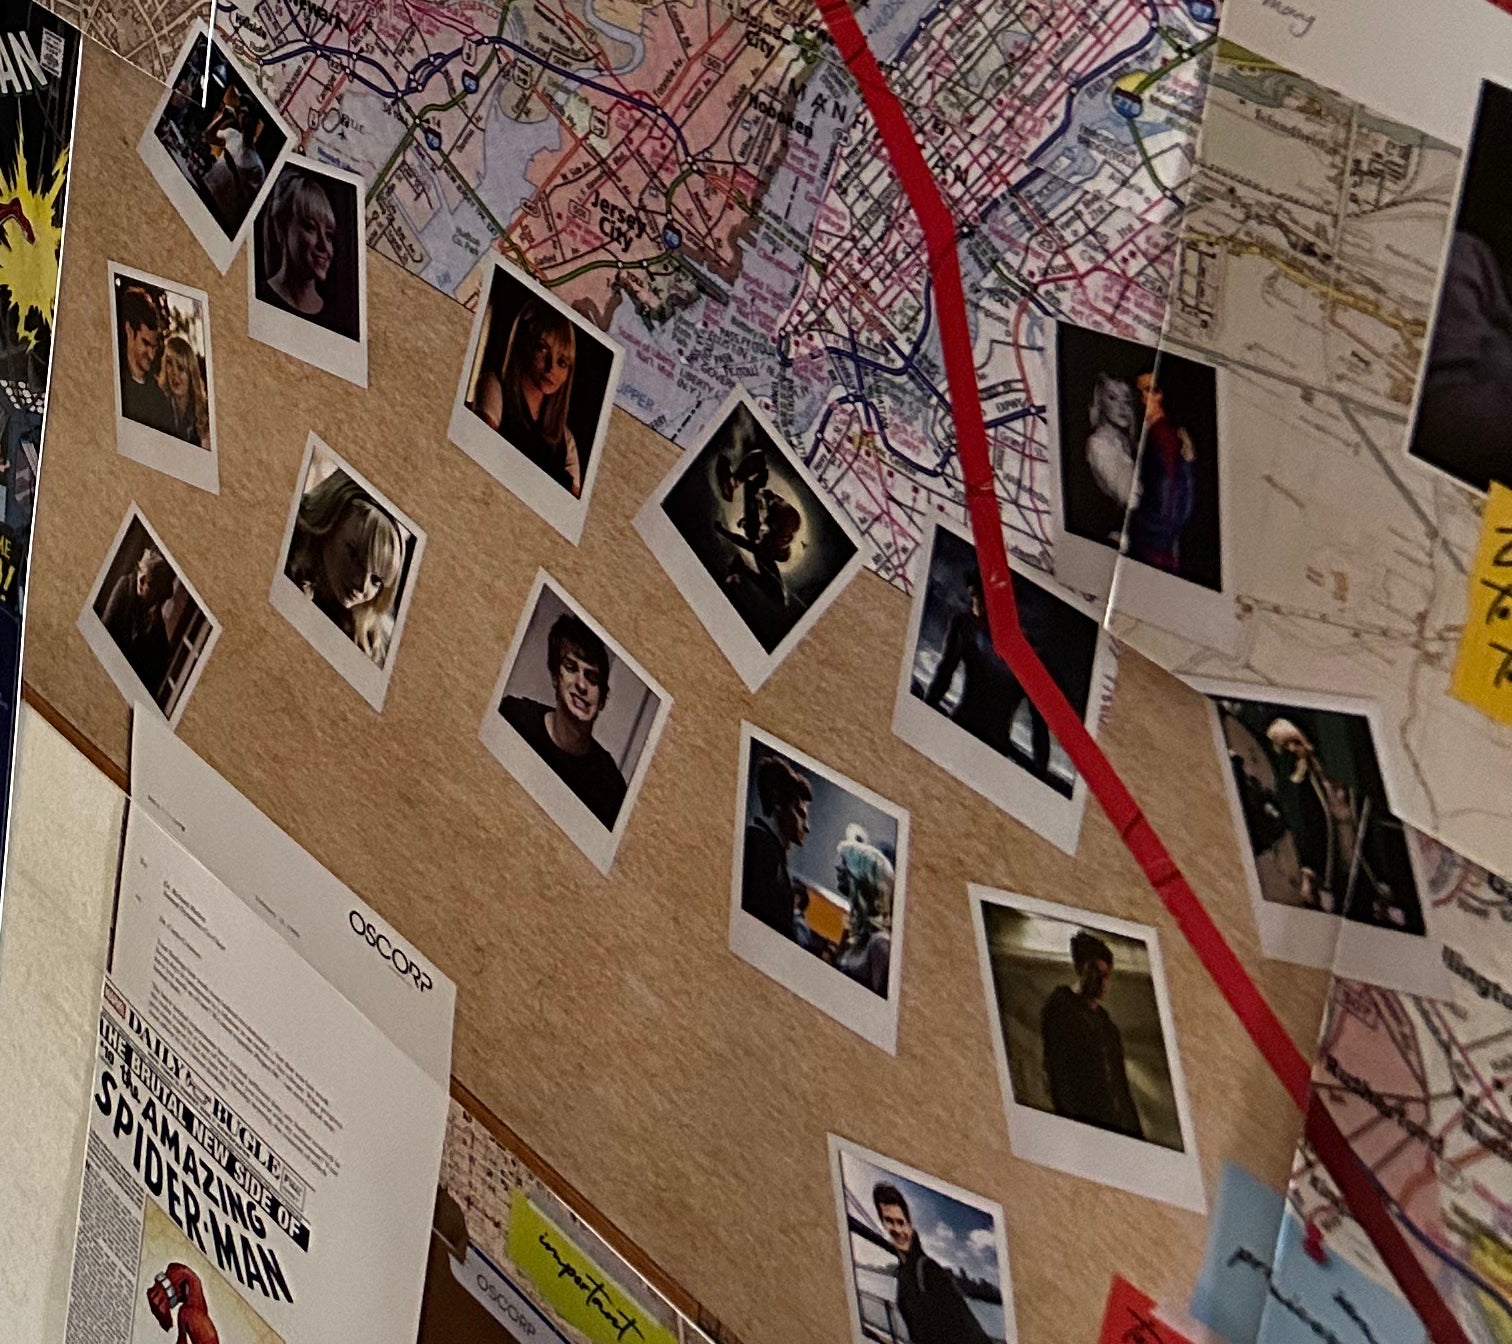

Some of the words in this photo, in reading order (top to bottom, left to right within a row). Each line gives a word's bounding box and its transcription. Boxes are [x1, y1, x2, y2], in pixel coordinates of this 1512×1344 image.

[591, 190, 646, 238] Jersey
[599, 217, 633, 252] City
[349, 910, 432, 992] OSCORP
[101, 1016, 127, 1058] THE
[132, 1049, 188, 1127] BRUTAL
[192, 1120, 229, 1167] NEW
[233, 1159, 271, 1212] SIDE
[278, 1209, 302, 1241] OF
[119, 1064, 141, 1105] the
[129, 1007, 185, 1083] DAILY
[211, 1095, 281, 1180] BUGLE
[95, 1070, 294, 1304] SPIDER-MAN
[142, 1097, 267, 1240] AMAZING
[476, 1273, 536, 1337] OSCORP
[539, 1232, 645, 1342] important
